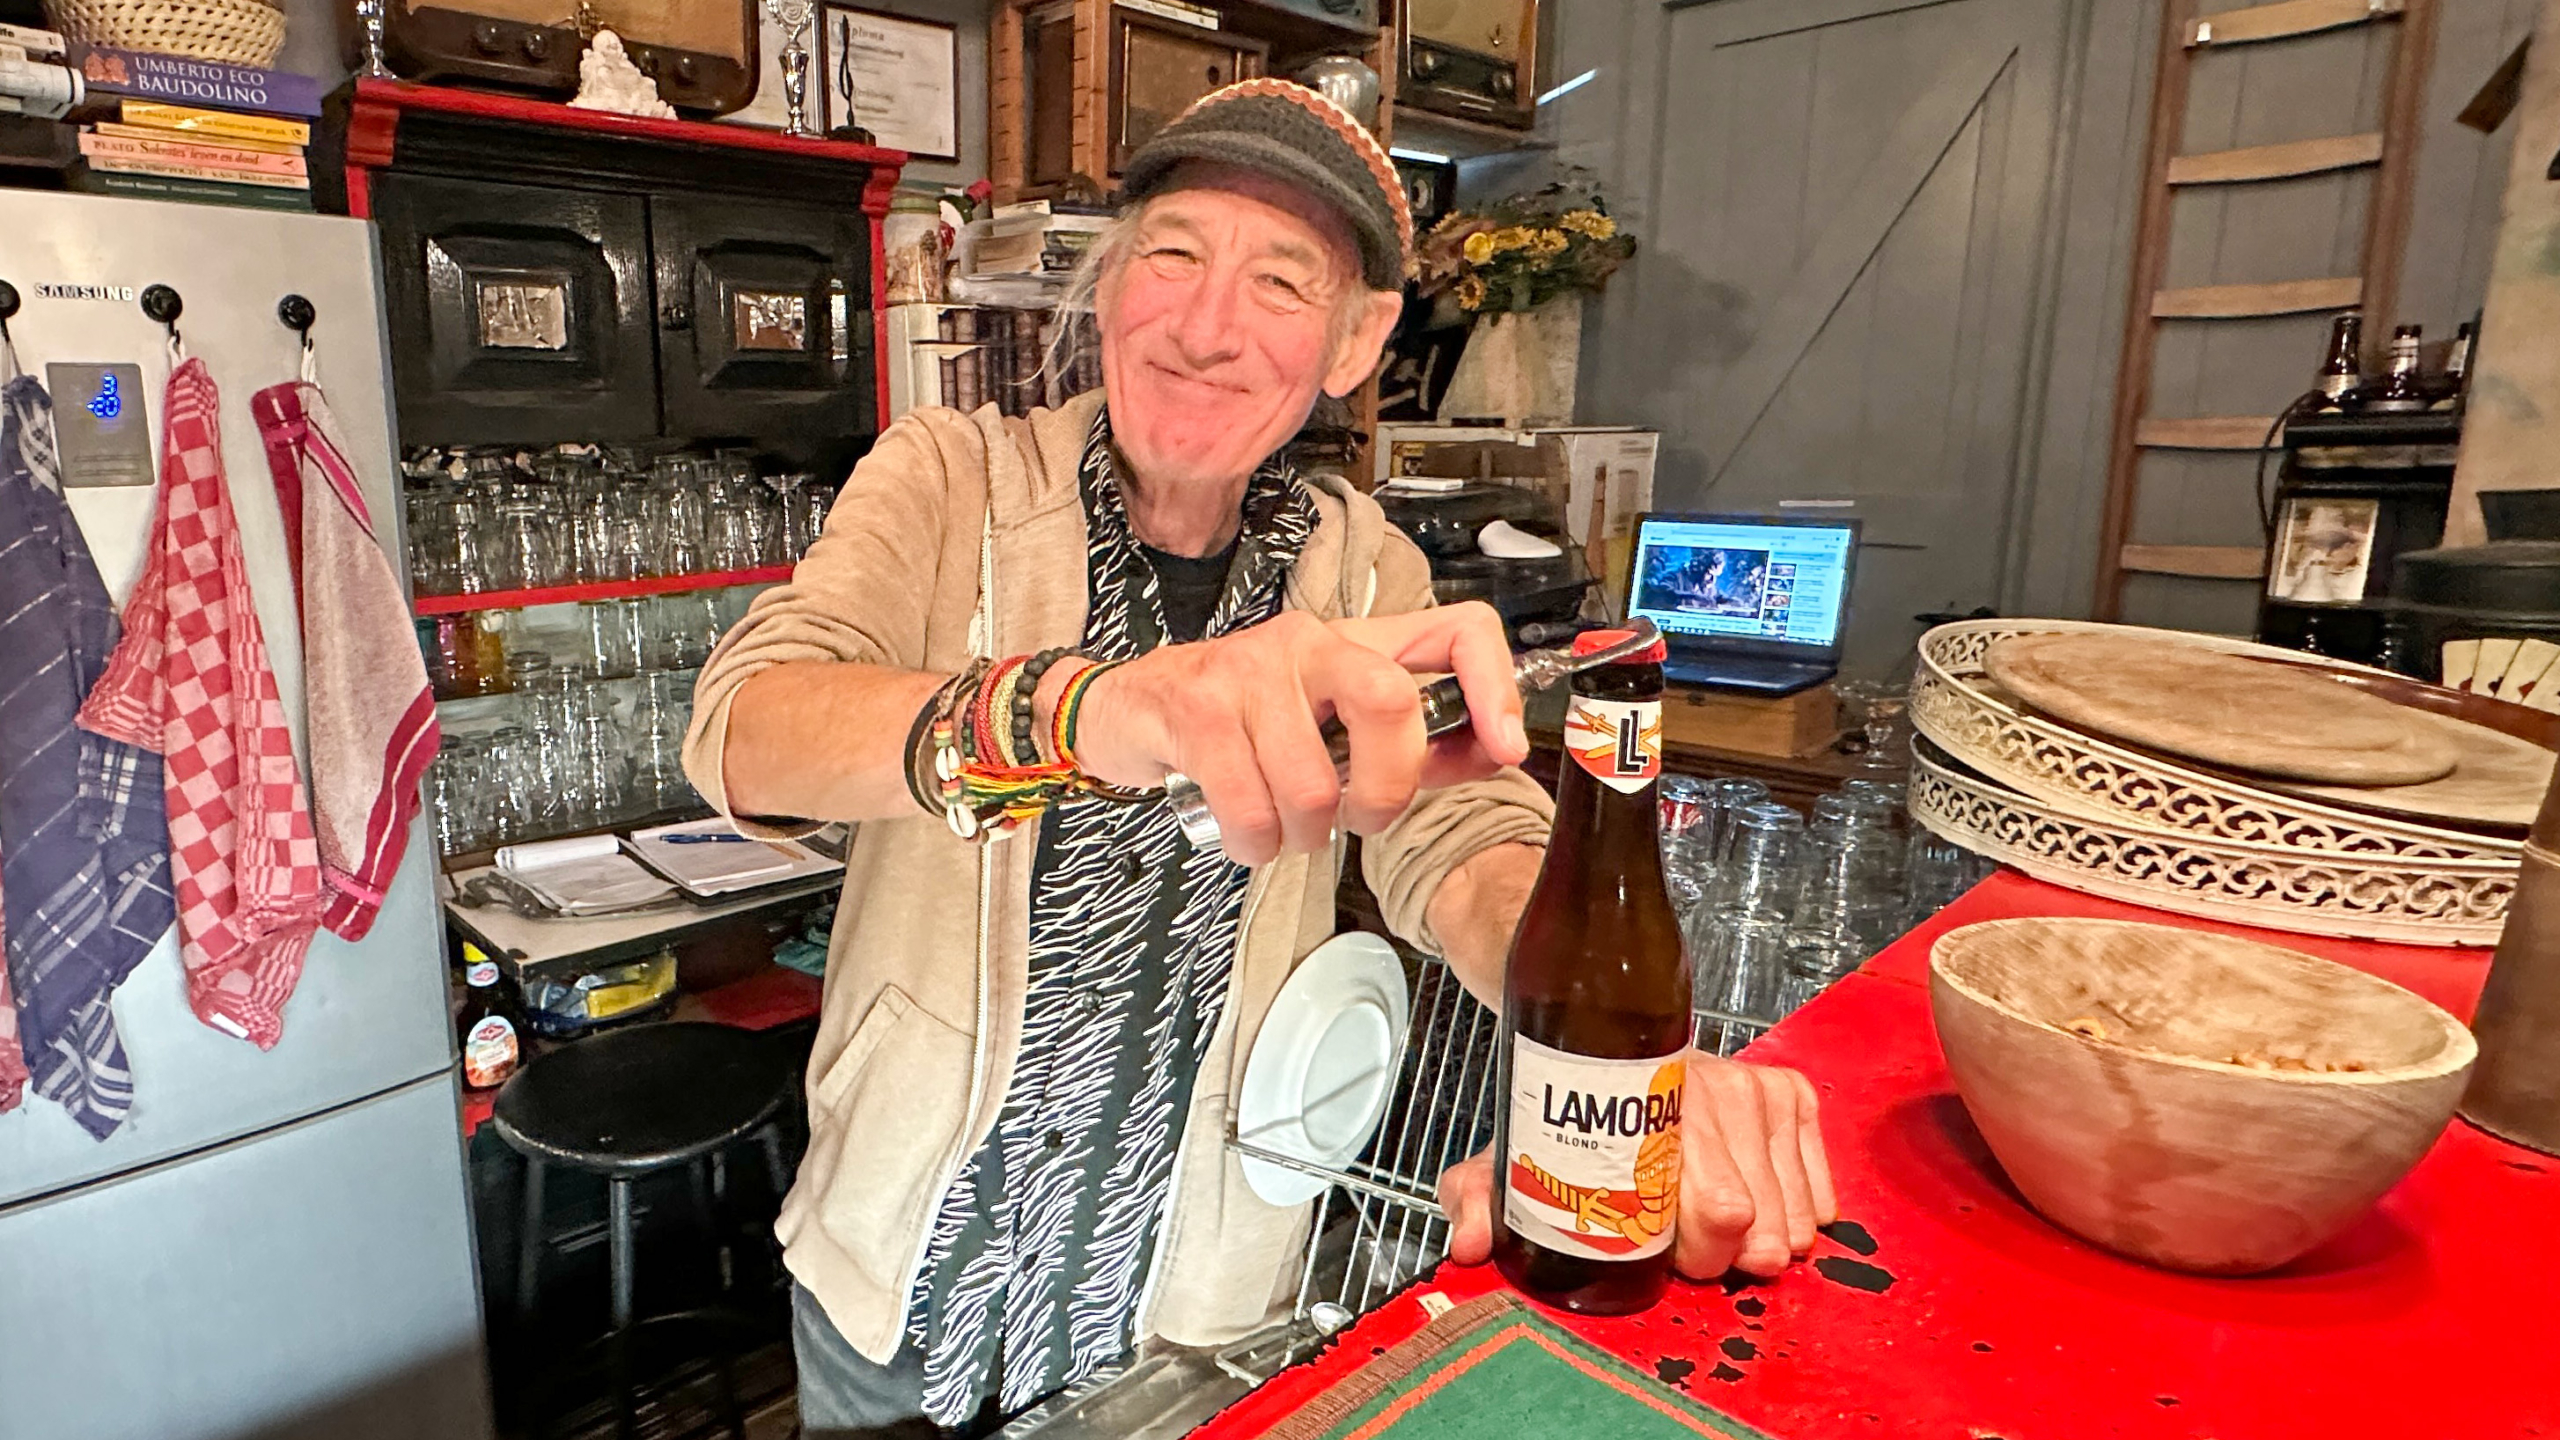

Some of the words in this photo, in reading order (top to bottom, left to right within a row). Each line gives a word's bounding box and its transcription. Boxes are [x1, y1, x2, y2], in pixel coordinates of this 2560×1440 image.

[136, 57, 223, 80] UMBERTO
[229, 68, 265, 86] ECO
[138, 73, 268, 105] BAUDOLINO
[94, 140, 135, 153] PLATO
[139, 142, 187, 158] Sokrates
[35, 284, 133, 301] SAMSUNG
[103, 376, 116, 395] 3
[1556, 1133, 1599, 1150] BLOND
